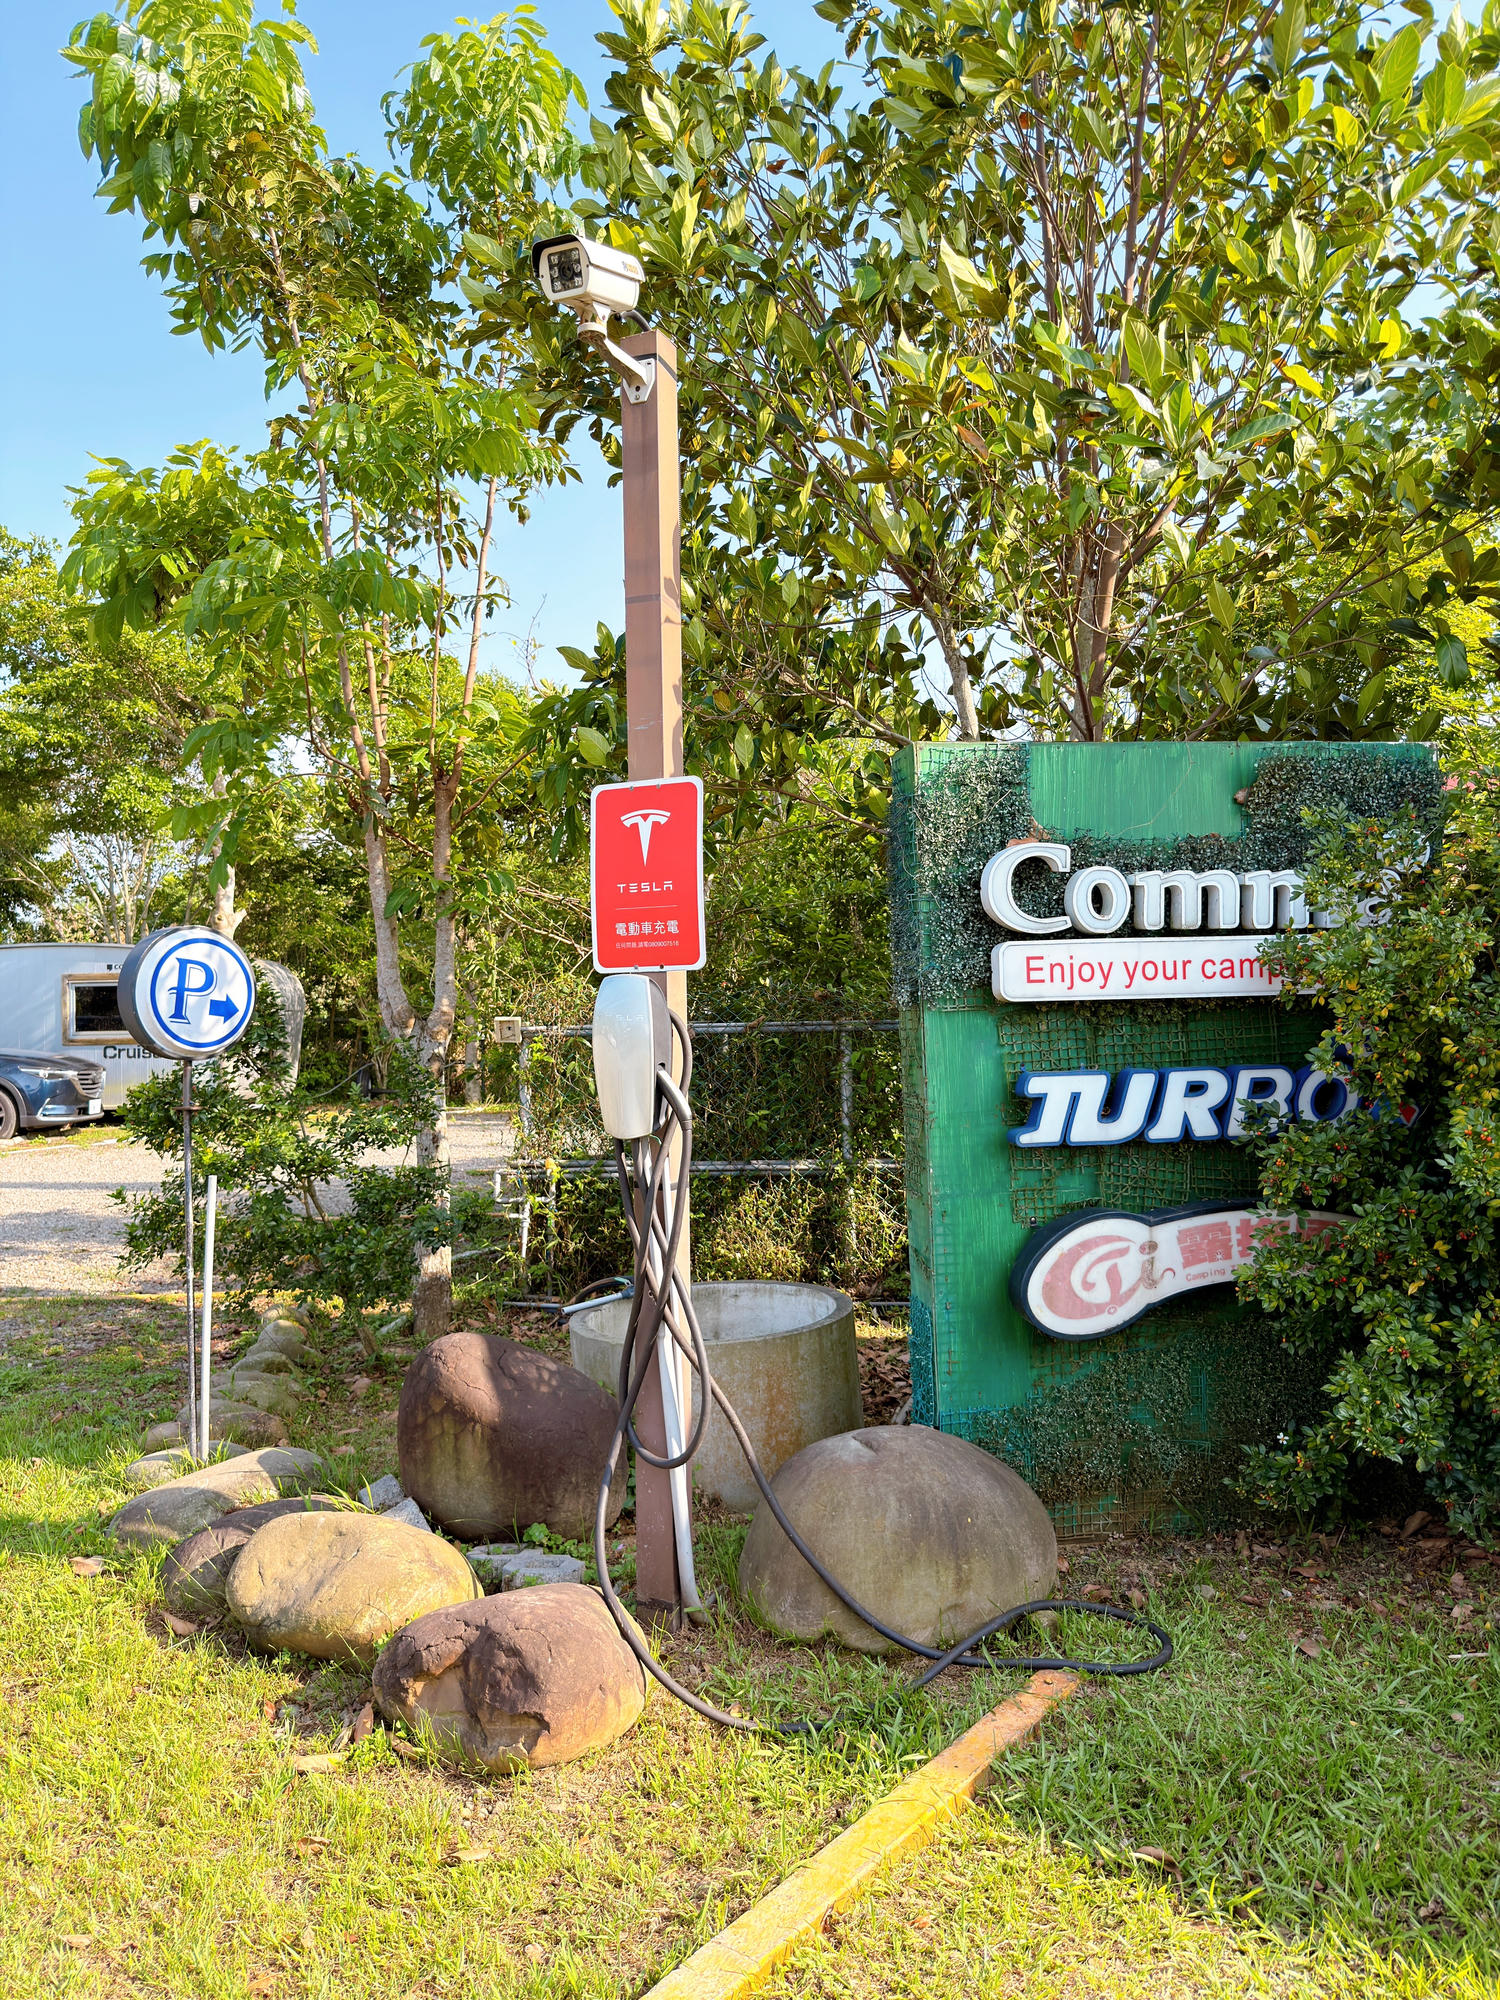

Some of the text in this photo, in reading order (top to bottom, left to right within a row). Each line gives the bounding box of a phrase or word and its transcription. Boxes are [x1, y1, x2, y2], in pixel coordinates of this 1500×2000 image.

[616, 880, 673, 893] TESLA
[615, 920, 680, 936] 電動車充電
[1024, 955, 1114, 989] Enjoy
[1123, 959, 1193, 987] your
[168, 957, 217, 1024] P
[1185, 1267, 1227, 1283] Camping
